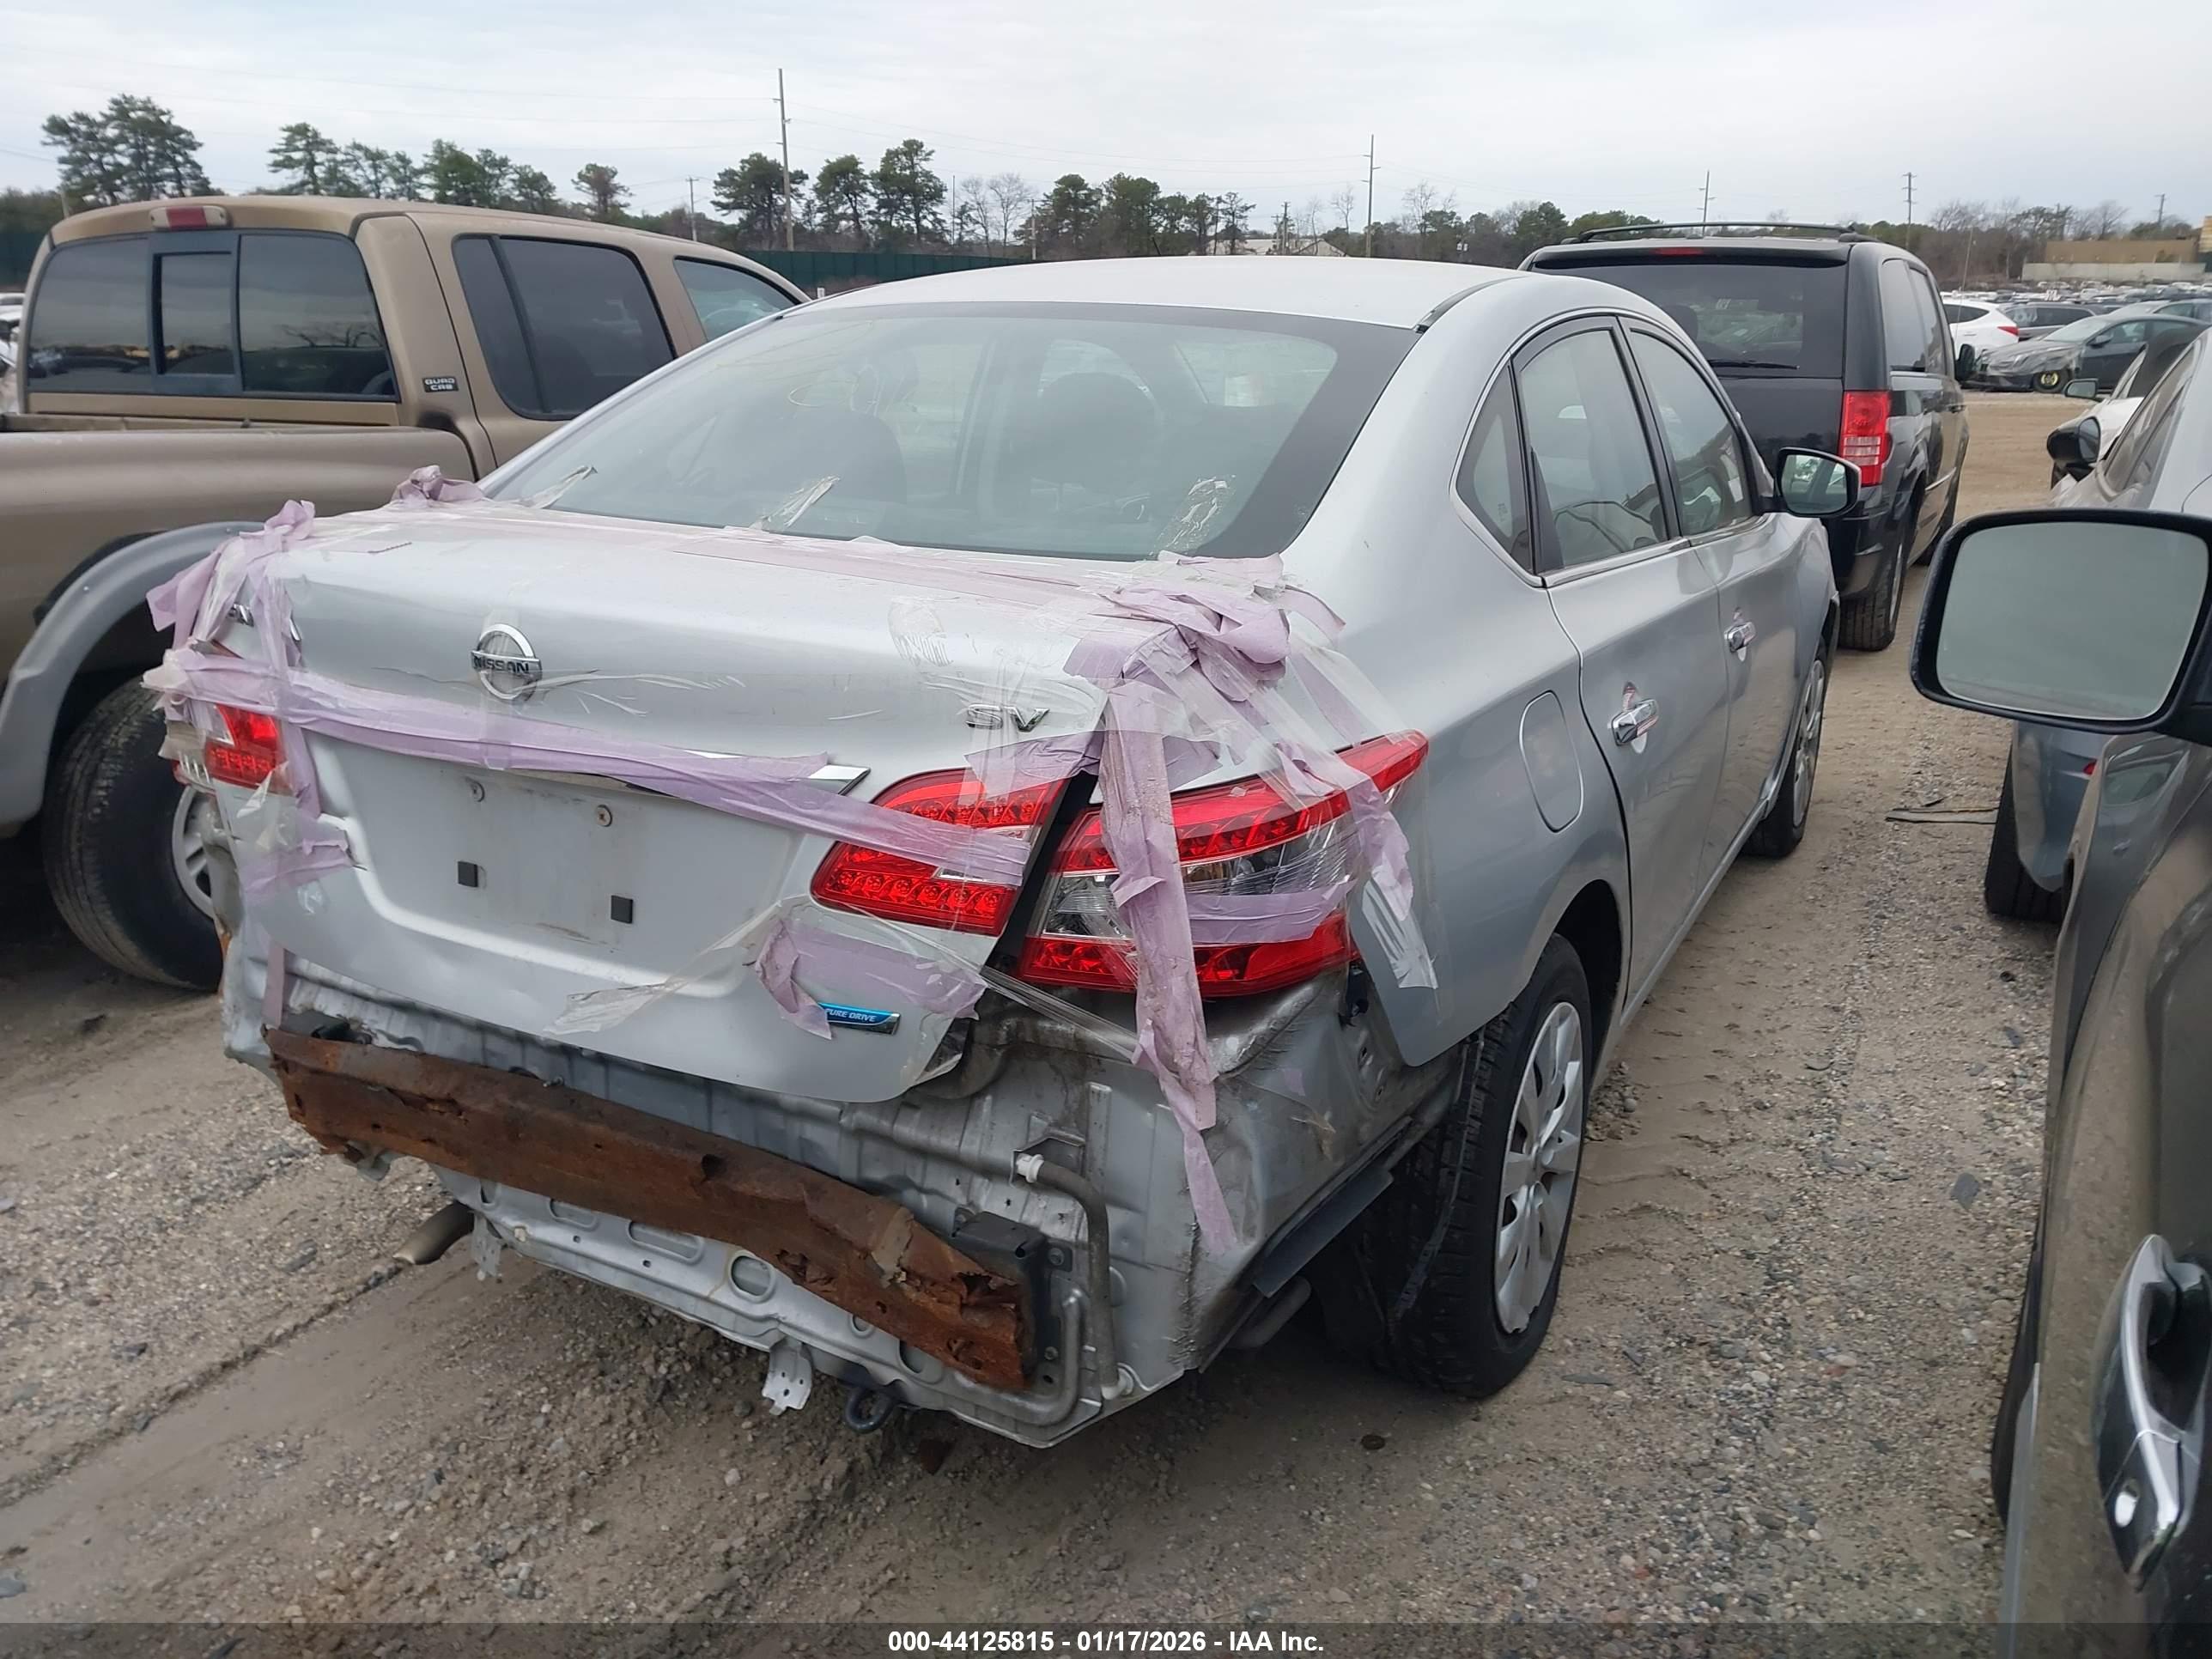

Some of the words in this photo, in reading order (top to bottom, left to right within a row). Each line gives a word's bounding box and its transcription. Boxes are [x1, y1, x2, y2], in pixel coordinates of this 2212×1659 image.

[473, 655, 530, 674] NISSAN
[965, 703, 1049, 732] SV
[849, 1012, 877, 1022] DRIVE
